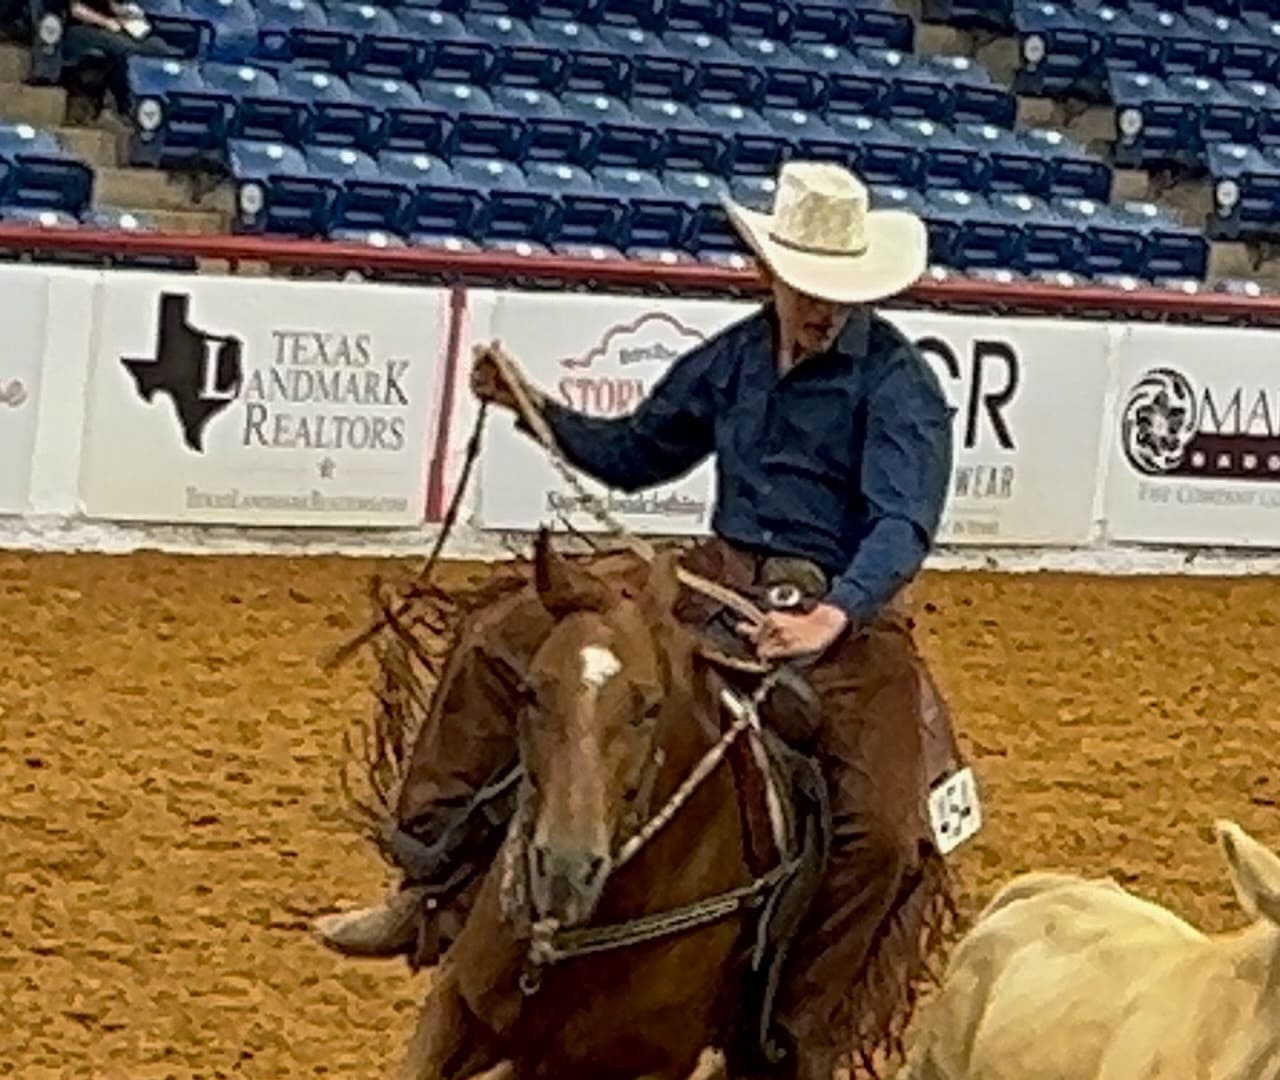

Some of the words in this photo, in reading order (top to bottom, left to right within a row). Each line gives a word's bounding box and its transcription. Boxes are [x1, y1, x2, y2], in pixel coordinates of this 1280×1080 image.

[272, 330, 371, 367] TEXAS
[559, 377, 645, 413] STOR
[243, 403, 405, 450] REALTORS
